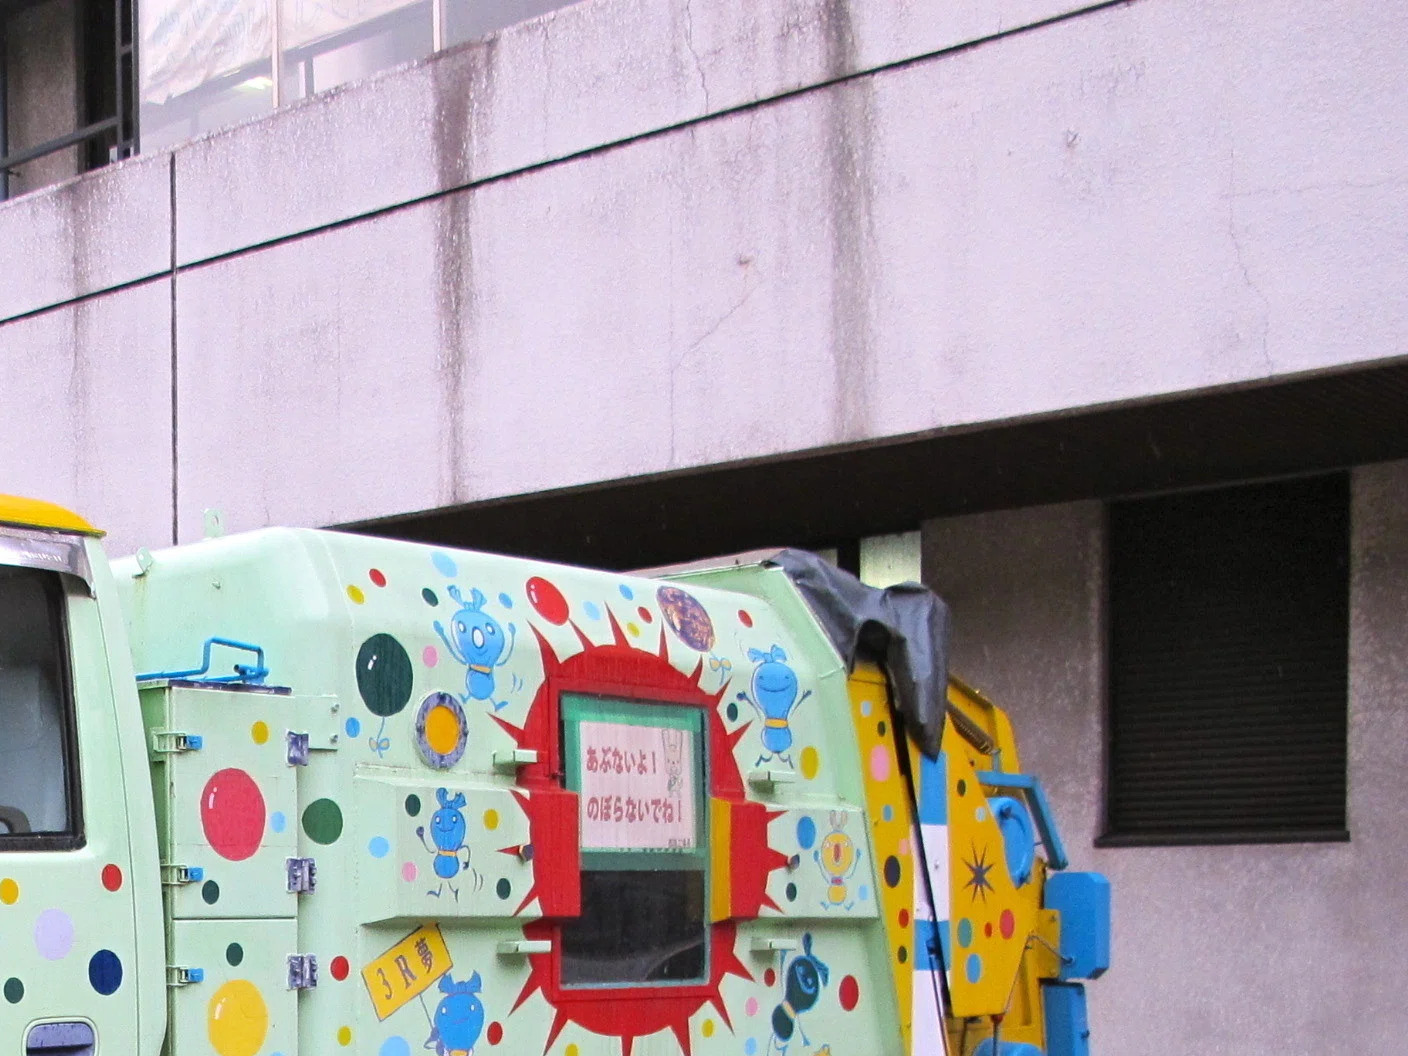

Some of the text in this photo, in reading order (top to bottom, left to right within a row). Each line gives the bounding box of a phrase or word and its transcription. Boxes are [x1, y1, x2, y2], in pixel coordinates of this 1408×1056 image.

[586, 746, 657, 775] あぶないよ！
[586, 795, 682, 823] のぼらないでね！
